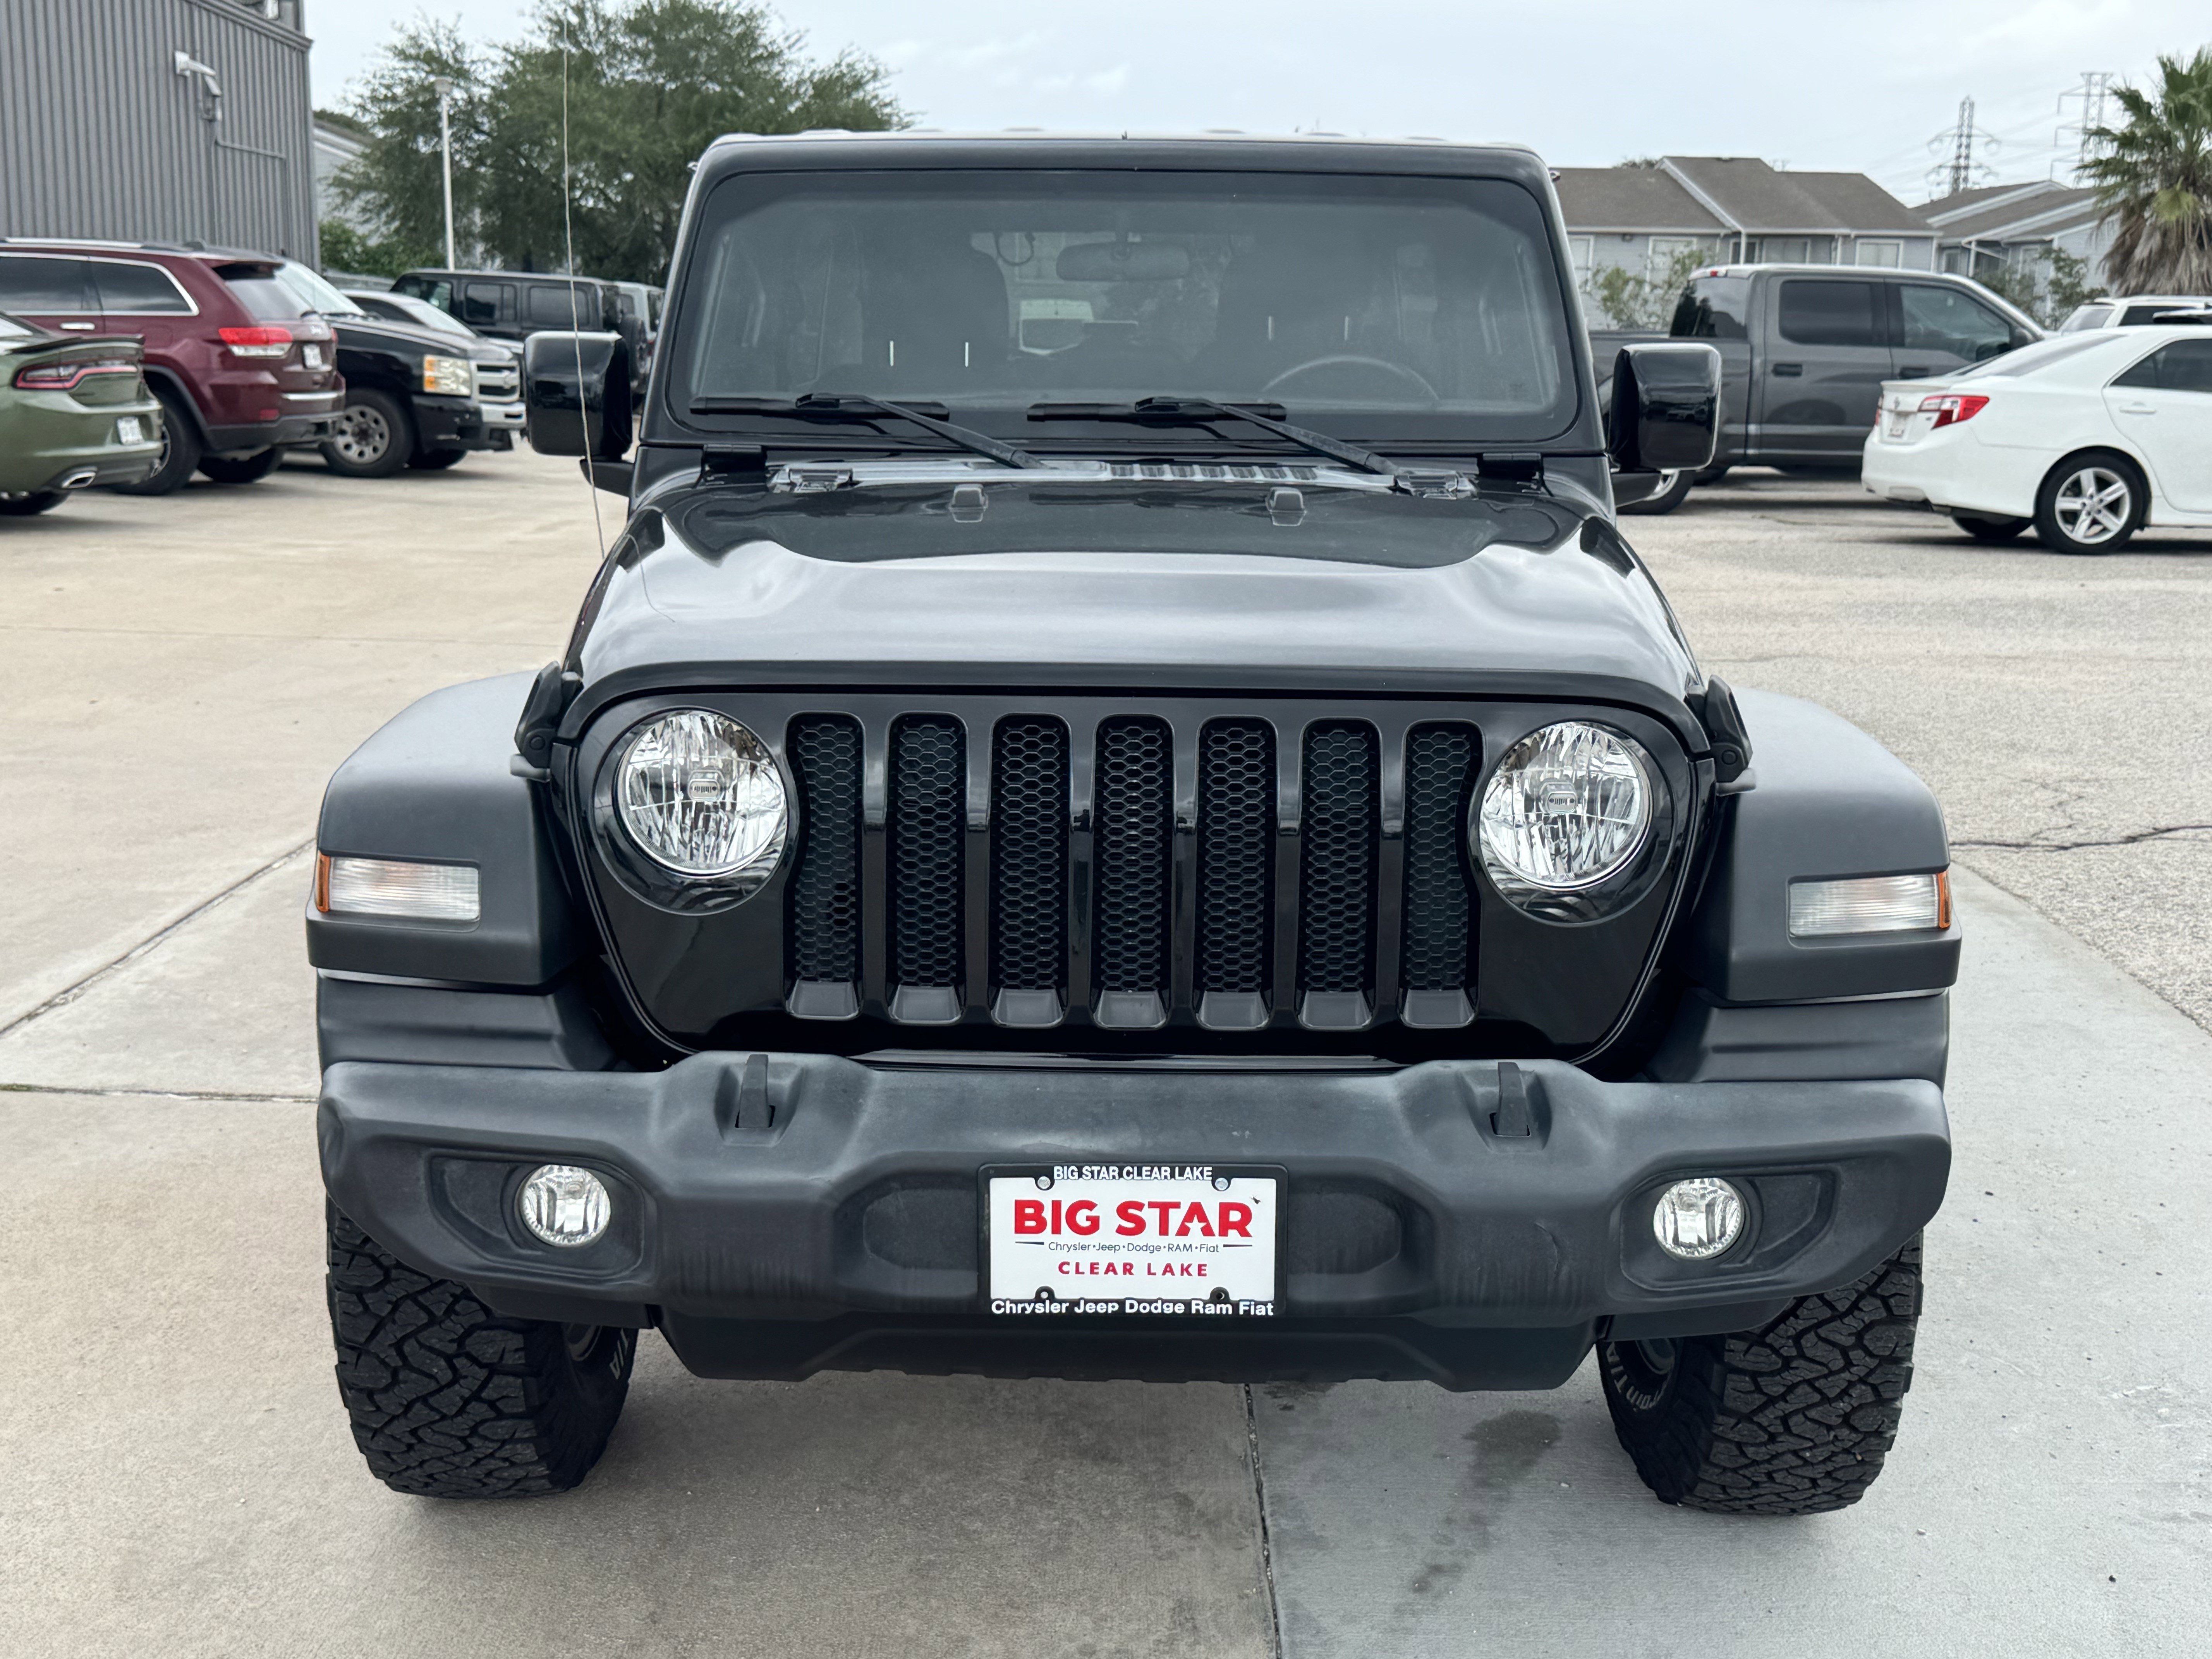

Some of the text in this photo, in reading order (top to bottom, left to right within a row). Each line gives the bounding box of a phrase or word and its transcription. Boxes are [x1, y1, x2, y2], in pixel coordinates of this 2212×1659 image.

[1053, 1166, 1212, 1180] BIG STAR CLEAR LAKE
[1014, 1199, 1252, 1237] BIG STAR
[1048, 1242, 1219, 1254] Chrysler Jeep Dodge RAM Fiat
[1058, 1261, 1207, 1277] CLEAR LAKE
[991, 1299, 1274, 1316] Chrysler Jeep Dodge Ram Fiat
